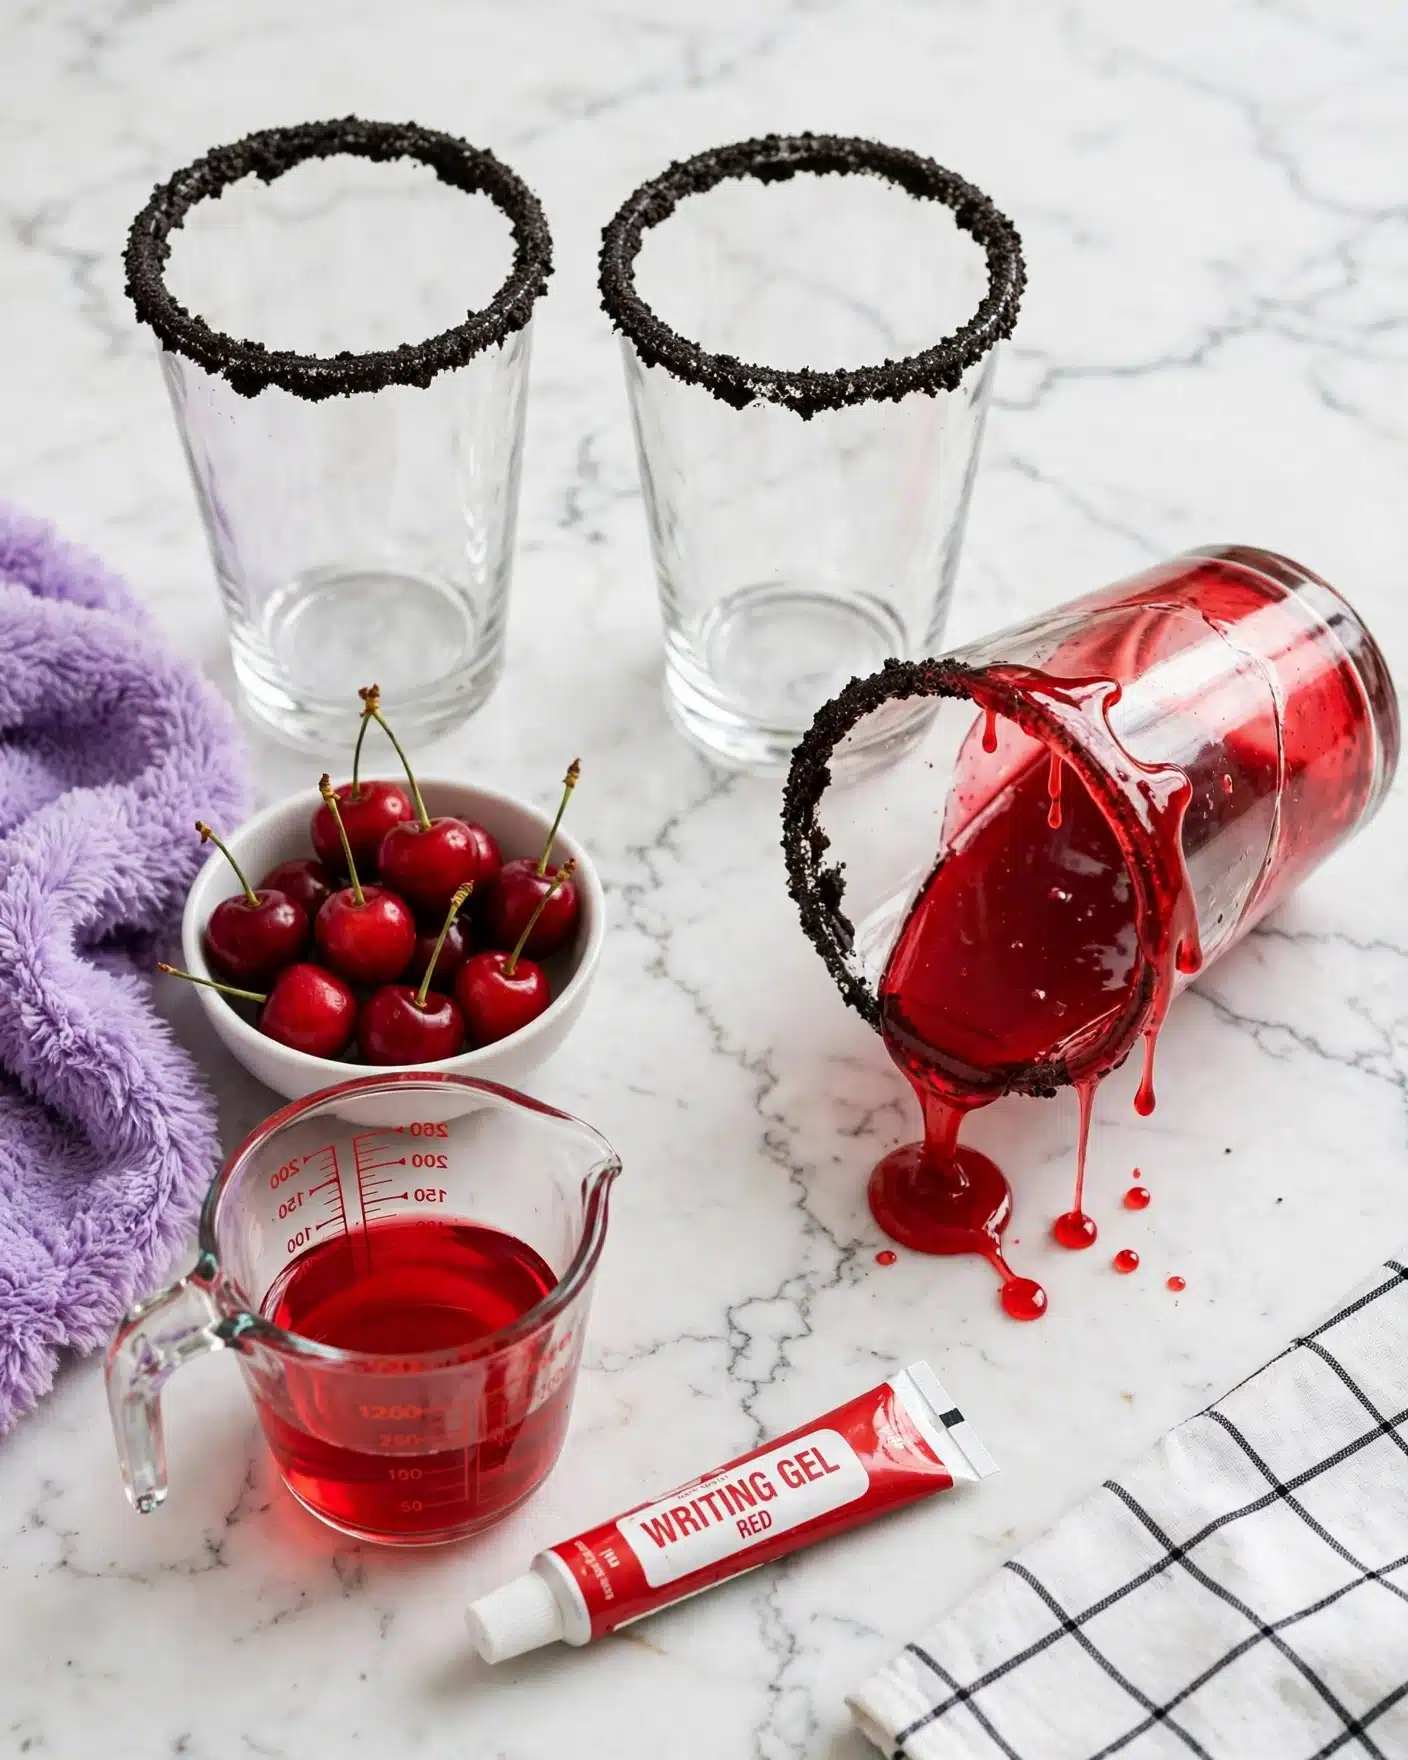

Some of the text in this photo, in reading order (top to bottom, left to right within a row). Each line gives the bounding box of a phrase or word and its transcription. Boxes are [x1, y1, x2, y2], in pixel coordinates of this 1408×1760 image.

[640, 1471, 778, 1549] WRITING
[776, 1446, 841, 1489] GEL
[736, 1509, 773, 1539] RED
